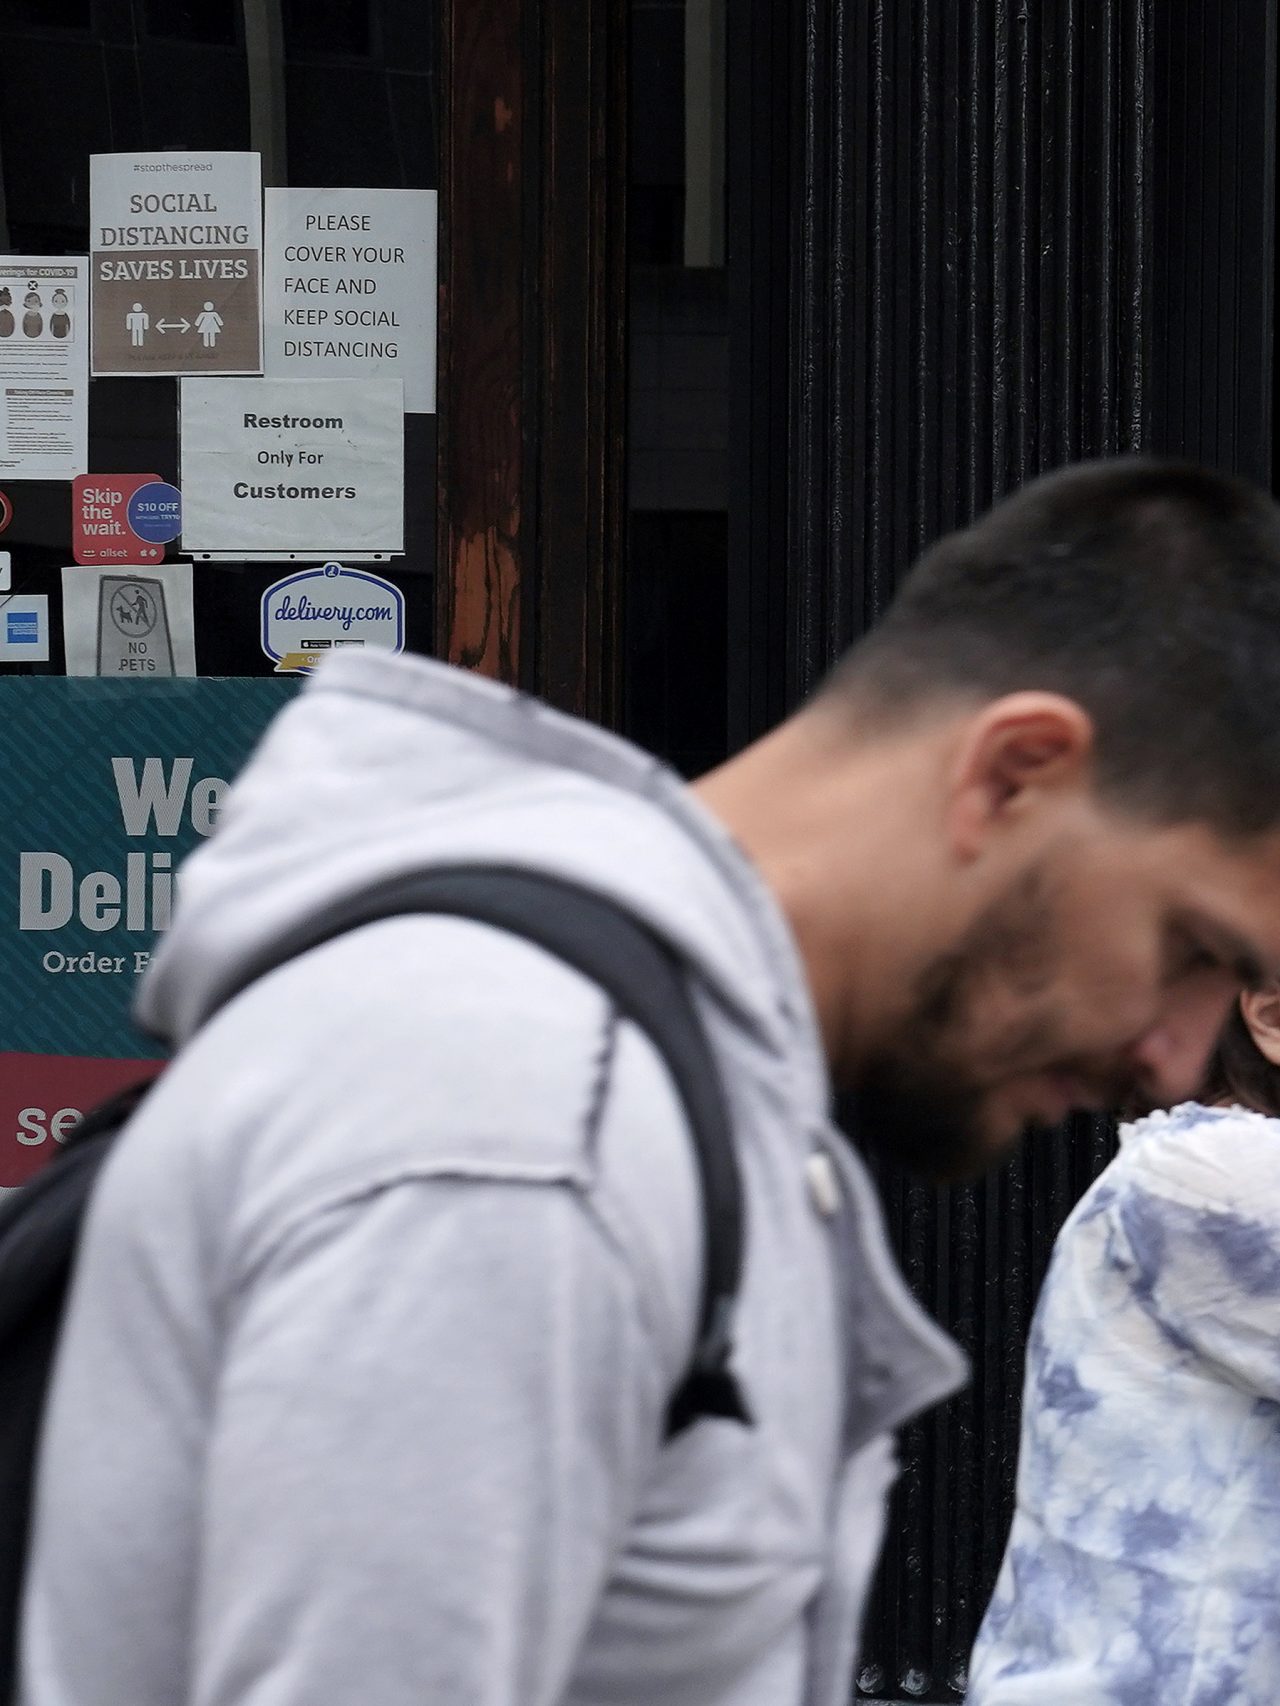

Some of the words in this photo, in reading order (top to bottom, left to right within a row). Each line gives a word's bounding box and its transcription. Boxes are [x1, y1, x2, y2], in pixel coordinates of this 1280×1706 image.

[133, 163, 213, 174] #stopthespread
[130, 193, 217, 214] SOCIAL
[305, 215, 371, 231] PLEASE
[100, 225, 249, 246] DISTANCING
[284, 246, 347, 263] COVER
[352, 247, 405, 264] YOUR
[39, 268, 75, 277] COVID-19
[100, 260, 174, 281] SAVES
[179, 258, 249, 280] LIVES
[284, 278, 330, 294] FACE
[335, 278, 377, 295] AND
[284, 309, 328, 326] KEEP
[334, 310, 400, 327] SOCIAL
[284, 341, 398, 359] DISTANCING
[243, 413, 343, 429] Restroom
[257, 450, 294, 468] Only
[298, 451, 324, 465] For
[82, 487, 123, 507] Skip
[233, 482, 357, 499] Customers
[81, 504, 113, 520] the
[137, 502, 157, 512] $10
[158, 502, 179, 512] OFF
[82, 520, 127, 536] wait.
[99, 548, 128, 558] allset
[274, 595, 393, 631] delivery.com
[128, 642, 148, 655] NO
[120, 659, 157, 672] PETS
[111, 756, 232, 839] We
[19, 850, 178, 932] Deli
[43, 951, 127, 974] Order
[133, 951, 156, 974] F
